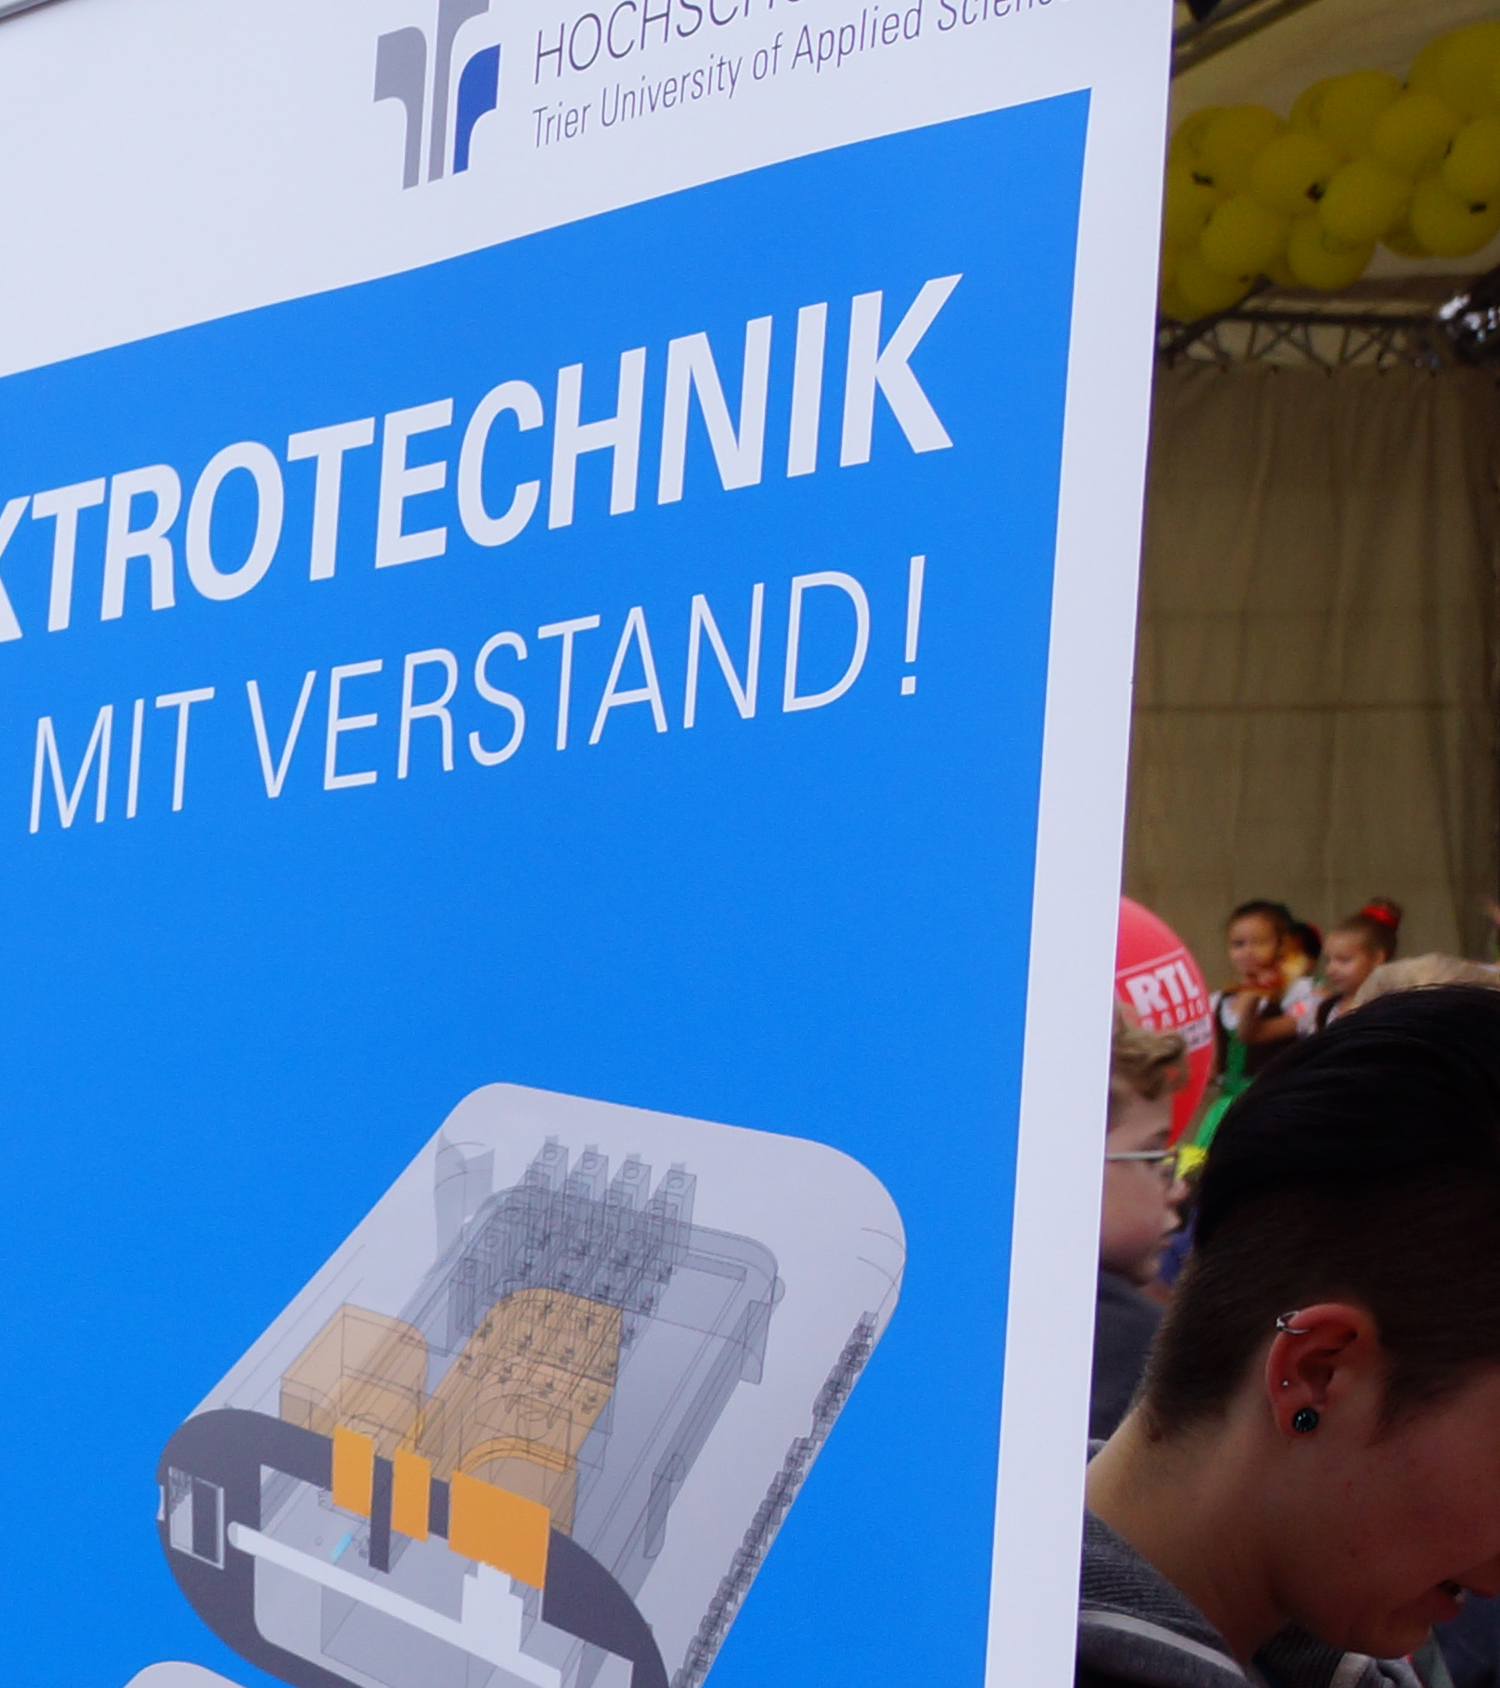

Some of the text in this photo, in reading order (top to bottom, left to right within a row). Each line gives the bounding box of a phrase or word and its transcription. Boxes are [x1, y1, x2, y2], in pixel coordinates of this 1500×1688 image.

[532, 101, 591, 148] Trier
[602, 53, 743, 127] University
[753, 31, 783, 80] of
[791, 0, 922, 73] Applied
[30, 687, 214, 833] MIT
[1124, 959, 1200, 1017] RTL
